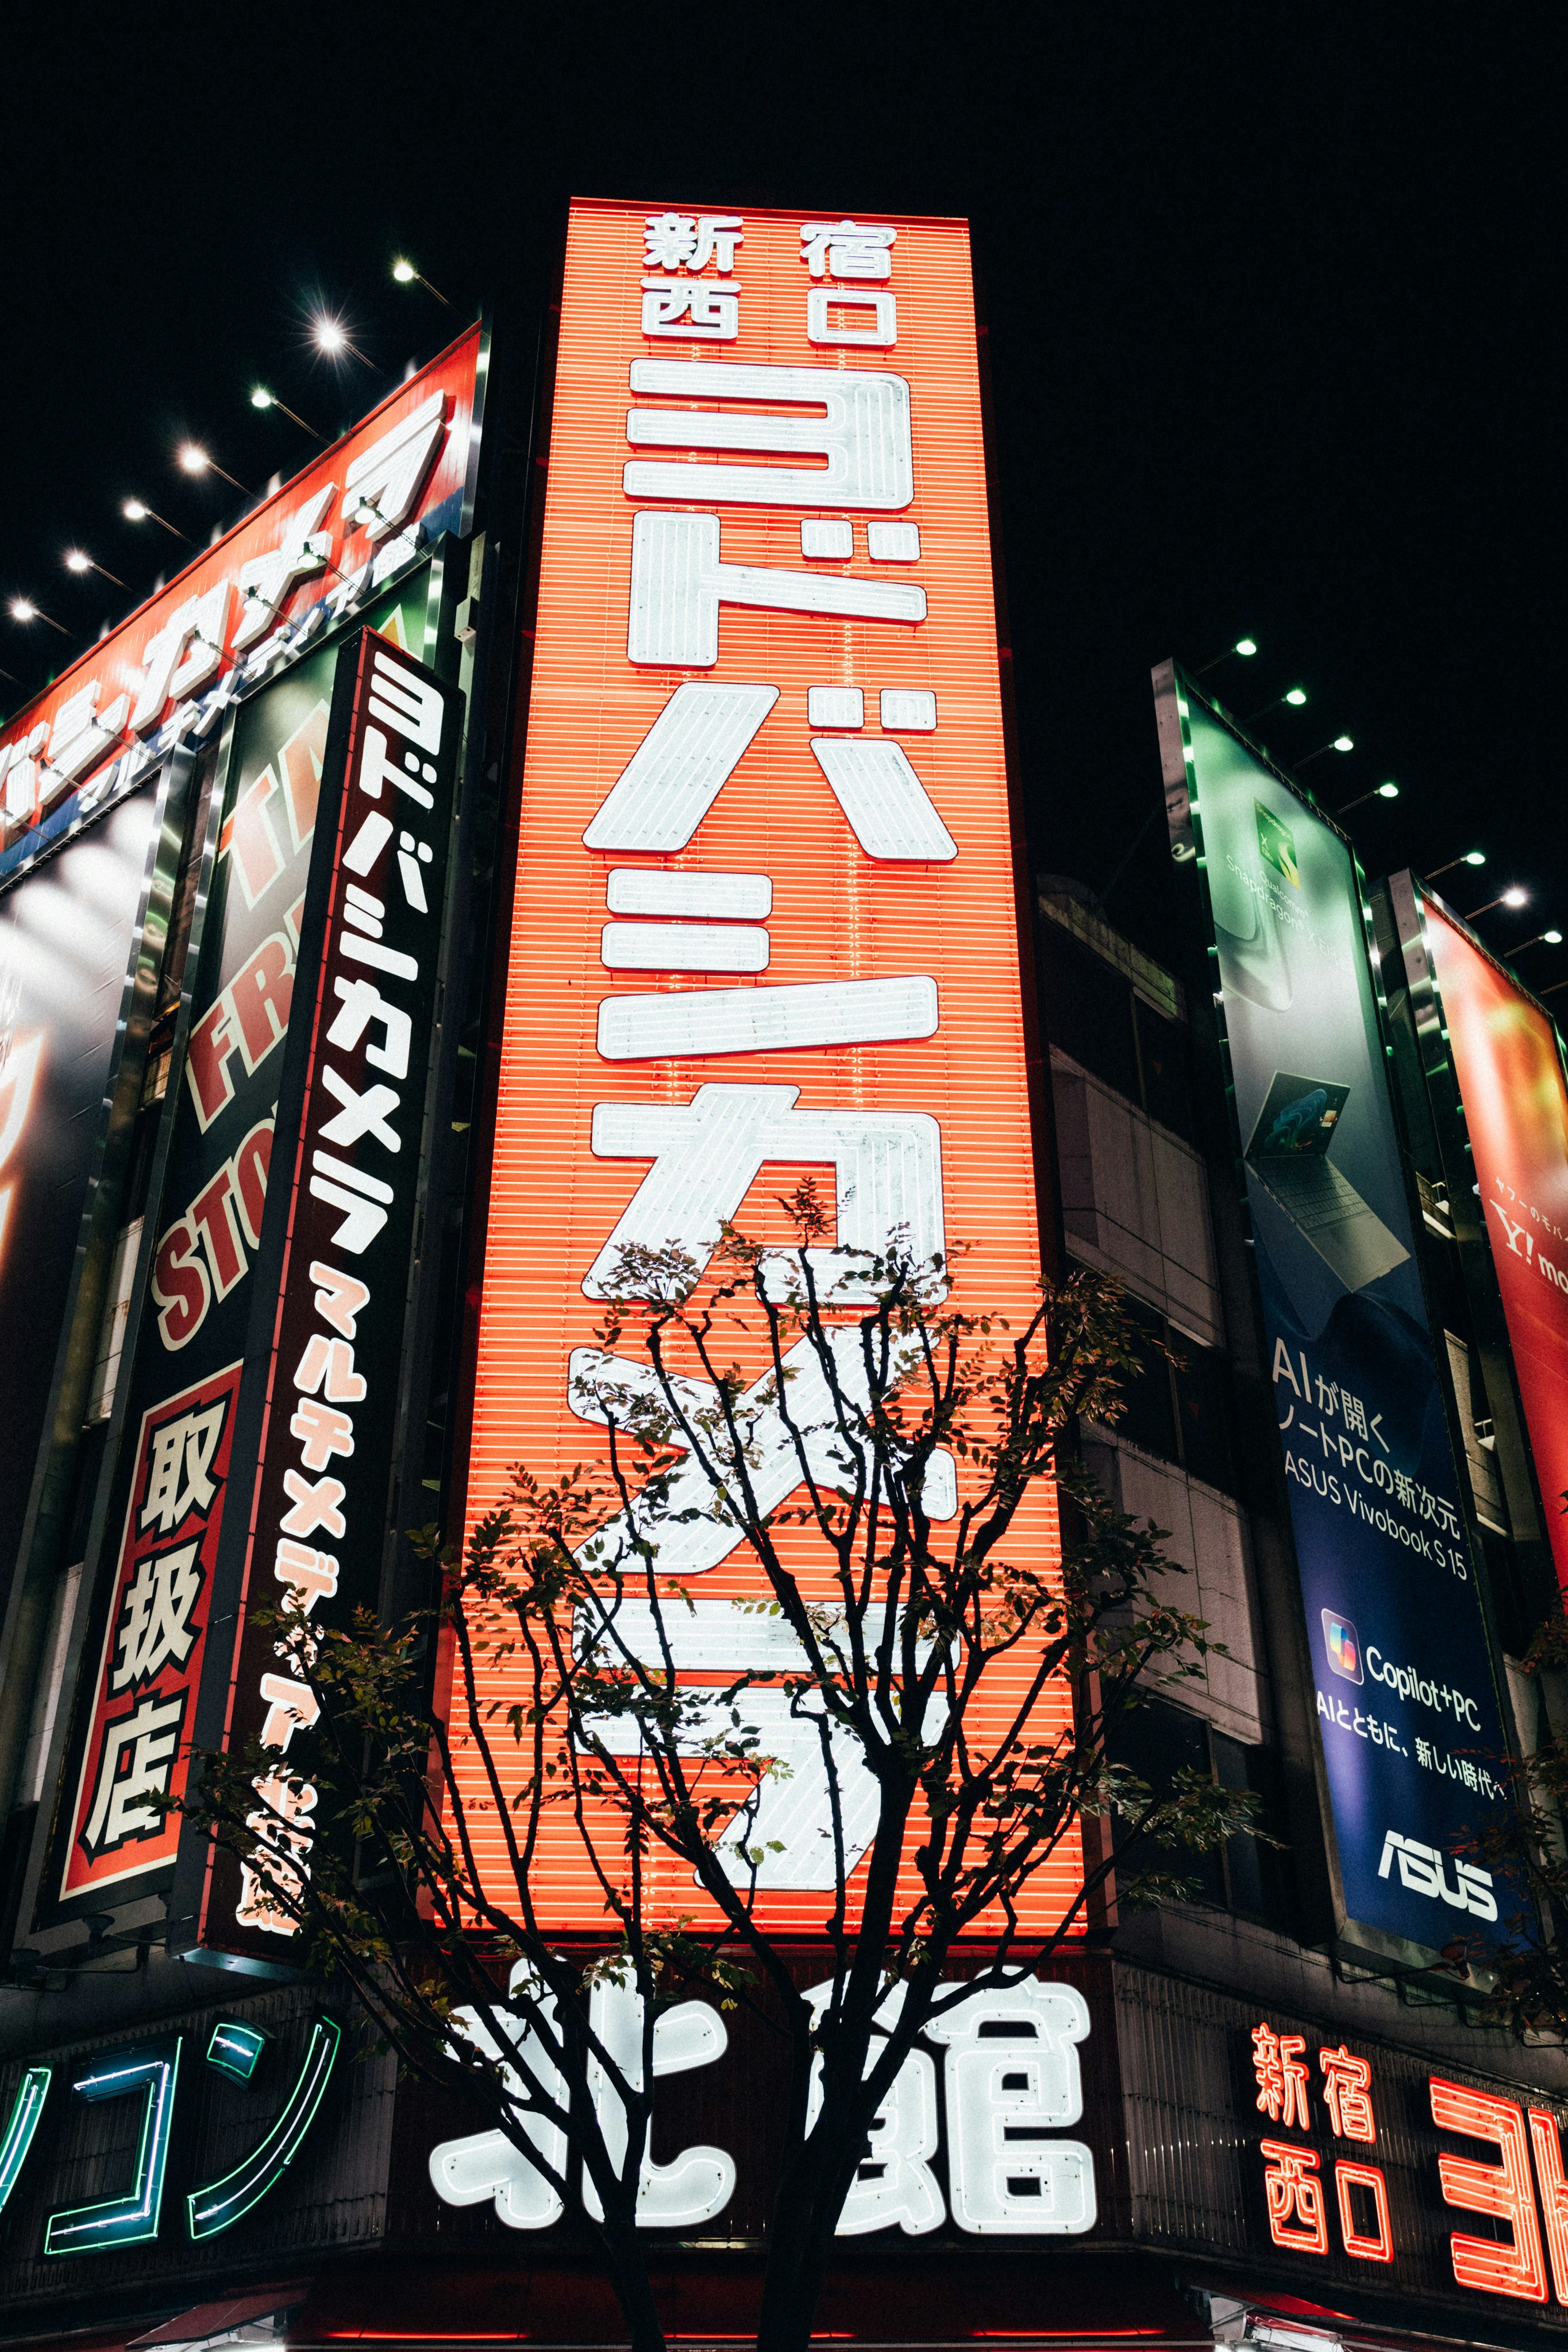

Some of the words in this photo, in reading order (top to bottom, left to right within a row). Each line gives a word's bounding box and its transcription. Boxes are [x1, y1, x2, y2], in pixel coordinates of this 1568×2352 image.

[641, 212, 898, 280] 新宿
[639, 277, 897, 345] 西口
[1260, 832, 1269, 850] X
[309, 651, 445, 1254] ヨドバシカメラ
[567, 359, 961, 1891] ヨドバシカメラ
[1495, 1176, 1568, 1244] ヤフーのモバ
[1272, 1337, 1390, 1453] AIが開く
[1278, 1405, 1460, 1540] ノートPCの新次元
[1285, 1450, 1341, 1504] ASUS
[1343, 1483, 1433, 1561] Vivobook
[1433, 1539, 1446, 1568] S
[1447, 1548, 1467, 1581] 15
[84, 1400, 226, 1850] 取扱店
[1378, 1830, 1498, 1922] ASUS
[429, 1954, 1098, 2236] 北館
[1251, 2022, 1376, 2144] 新宿
[1260, 2138, 1394, 2264] 西口
